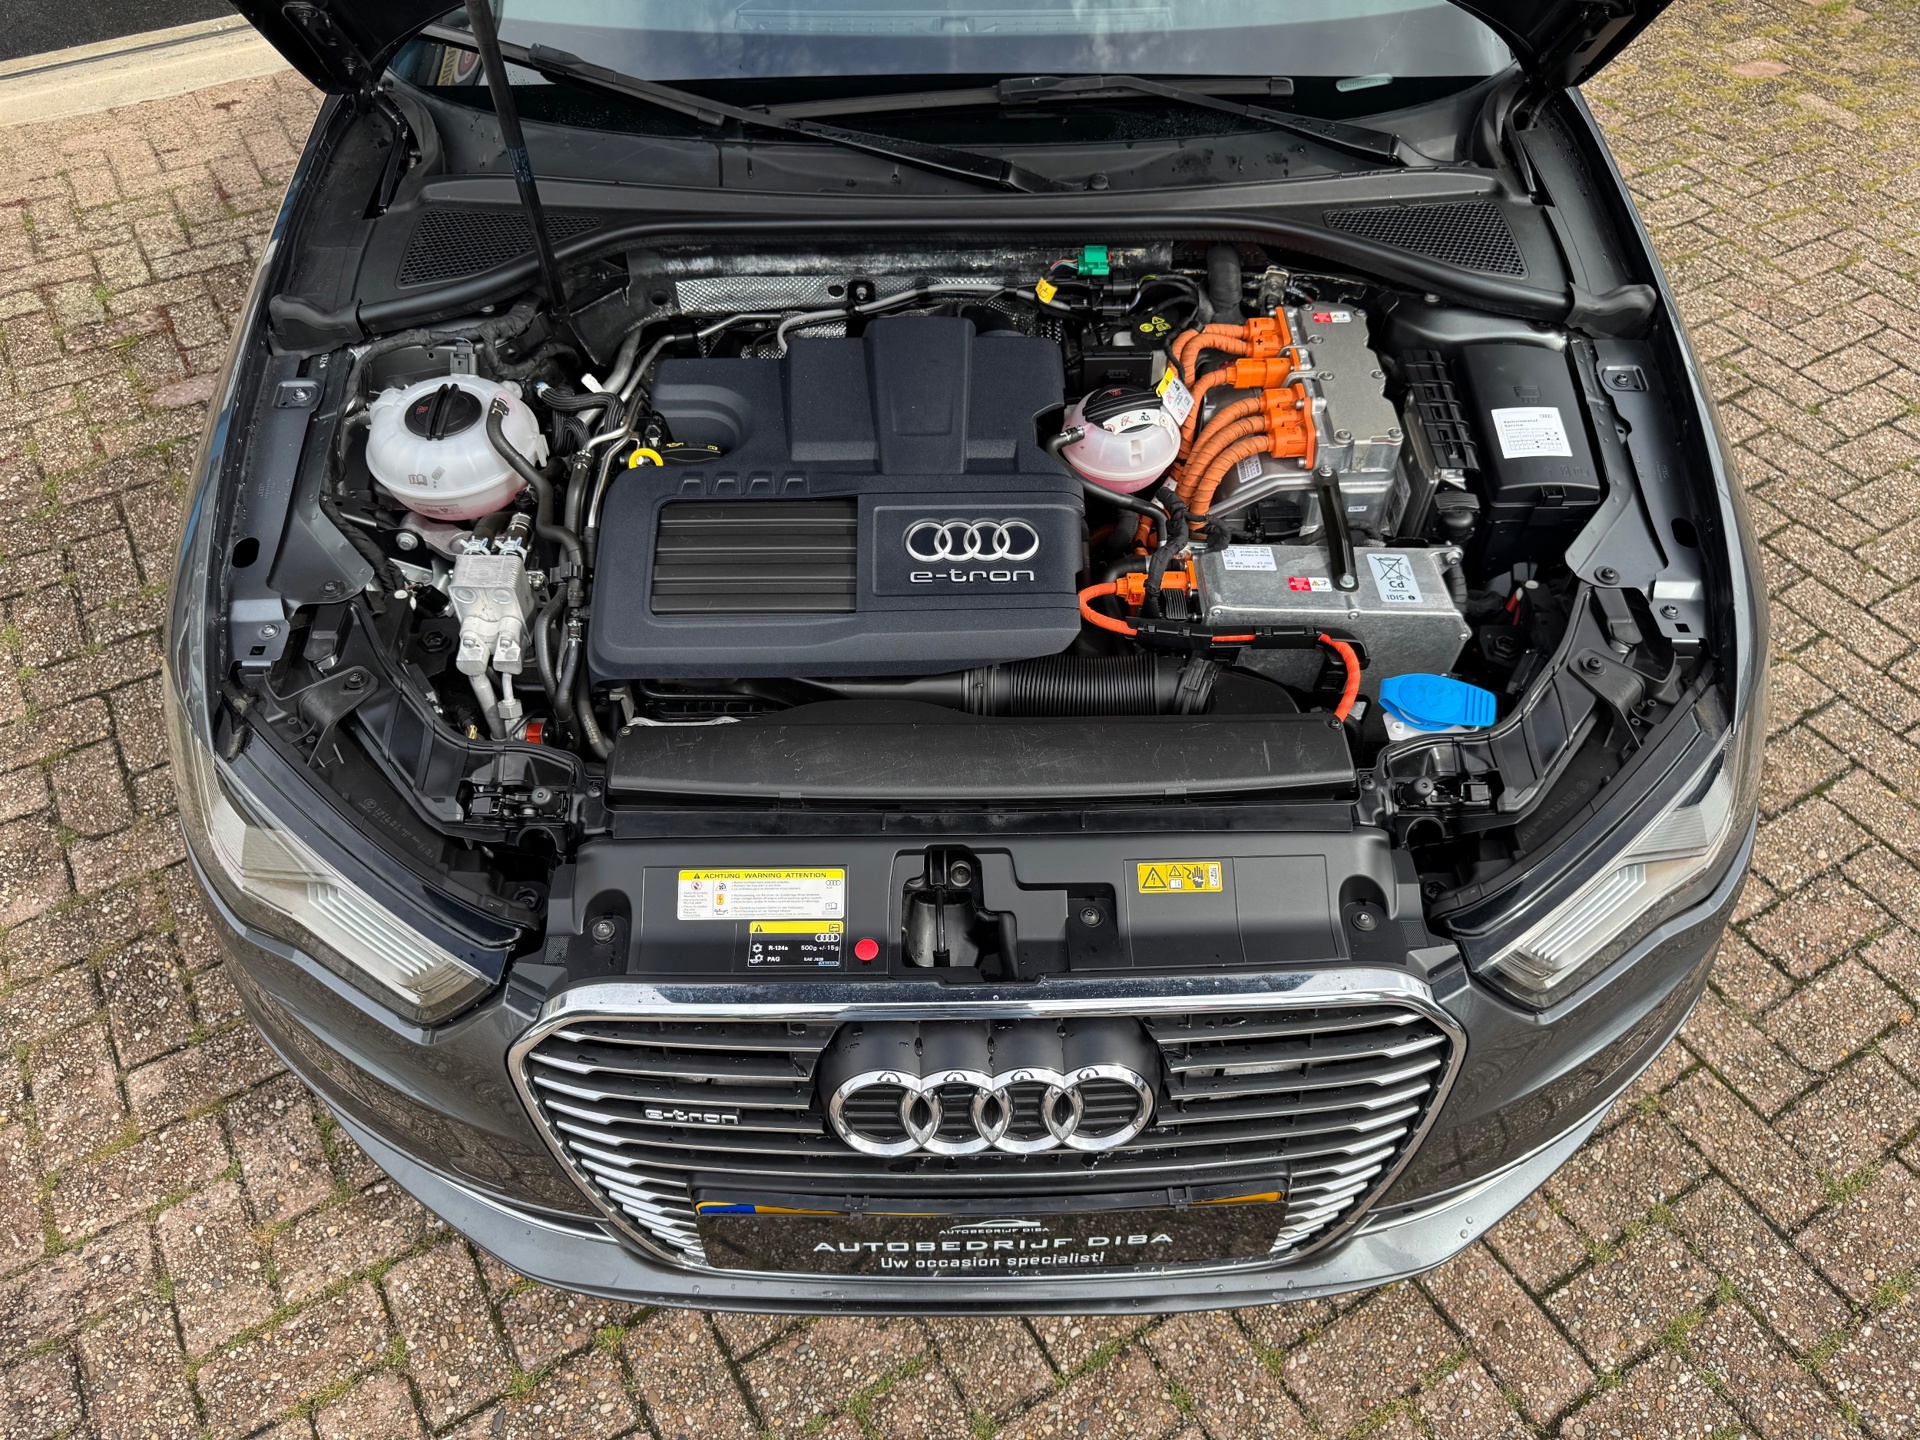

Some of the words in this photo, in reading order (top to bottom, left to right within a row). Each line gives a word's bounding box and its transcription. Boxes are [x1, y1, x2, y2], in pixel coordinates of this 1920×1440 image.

[910, 569, 1035, 583] e-tron
[1389, 580, 1405, 589] Cd
[801, 945, 818, 953] 500g
[645, 1109, 739, 1125] e-tron
[813, 1237, 1073, 1253] AUTOBEDRIJF
[1088, 1233, 1174, 1247] DIBA
[880, 1256, 911, 1269] Uw
[915, 1255, 1002, 1268] occasion
[1007, 1253, 1105, 1268] specialist!
